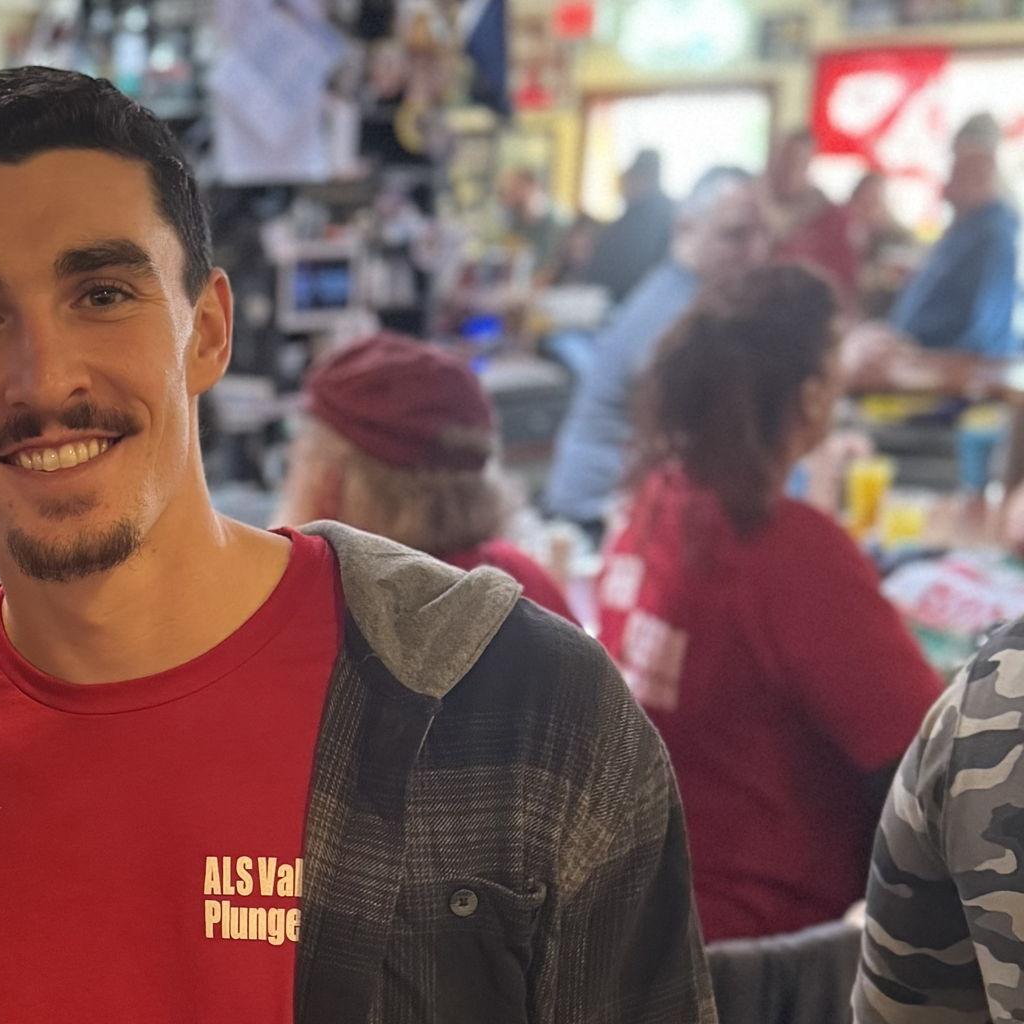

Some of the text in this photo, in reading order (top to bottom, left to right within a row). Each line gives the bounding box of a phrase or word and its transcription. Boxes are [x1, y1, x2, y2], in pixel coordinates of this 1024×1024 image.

[203, 856, 304, 897] ALS Val
[204, 899, 302, 946] Plunge
